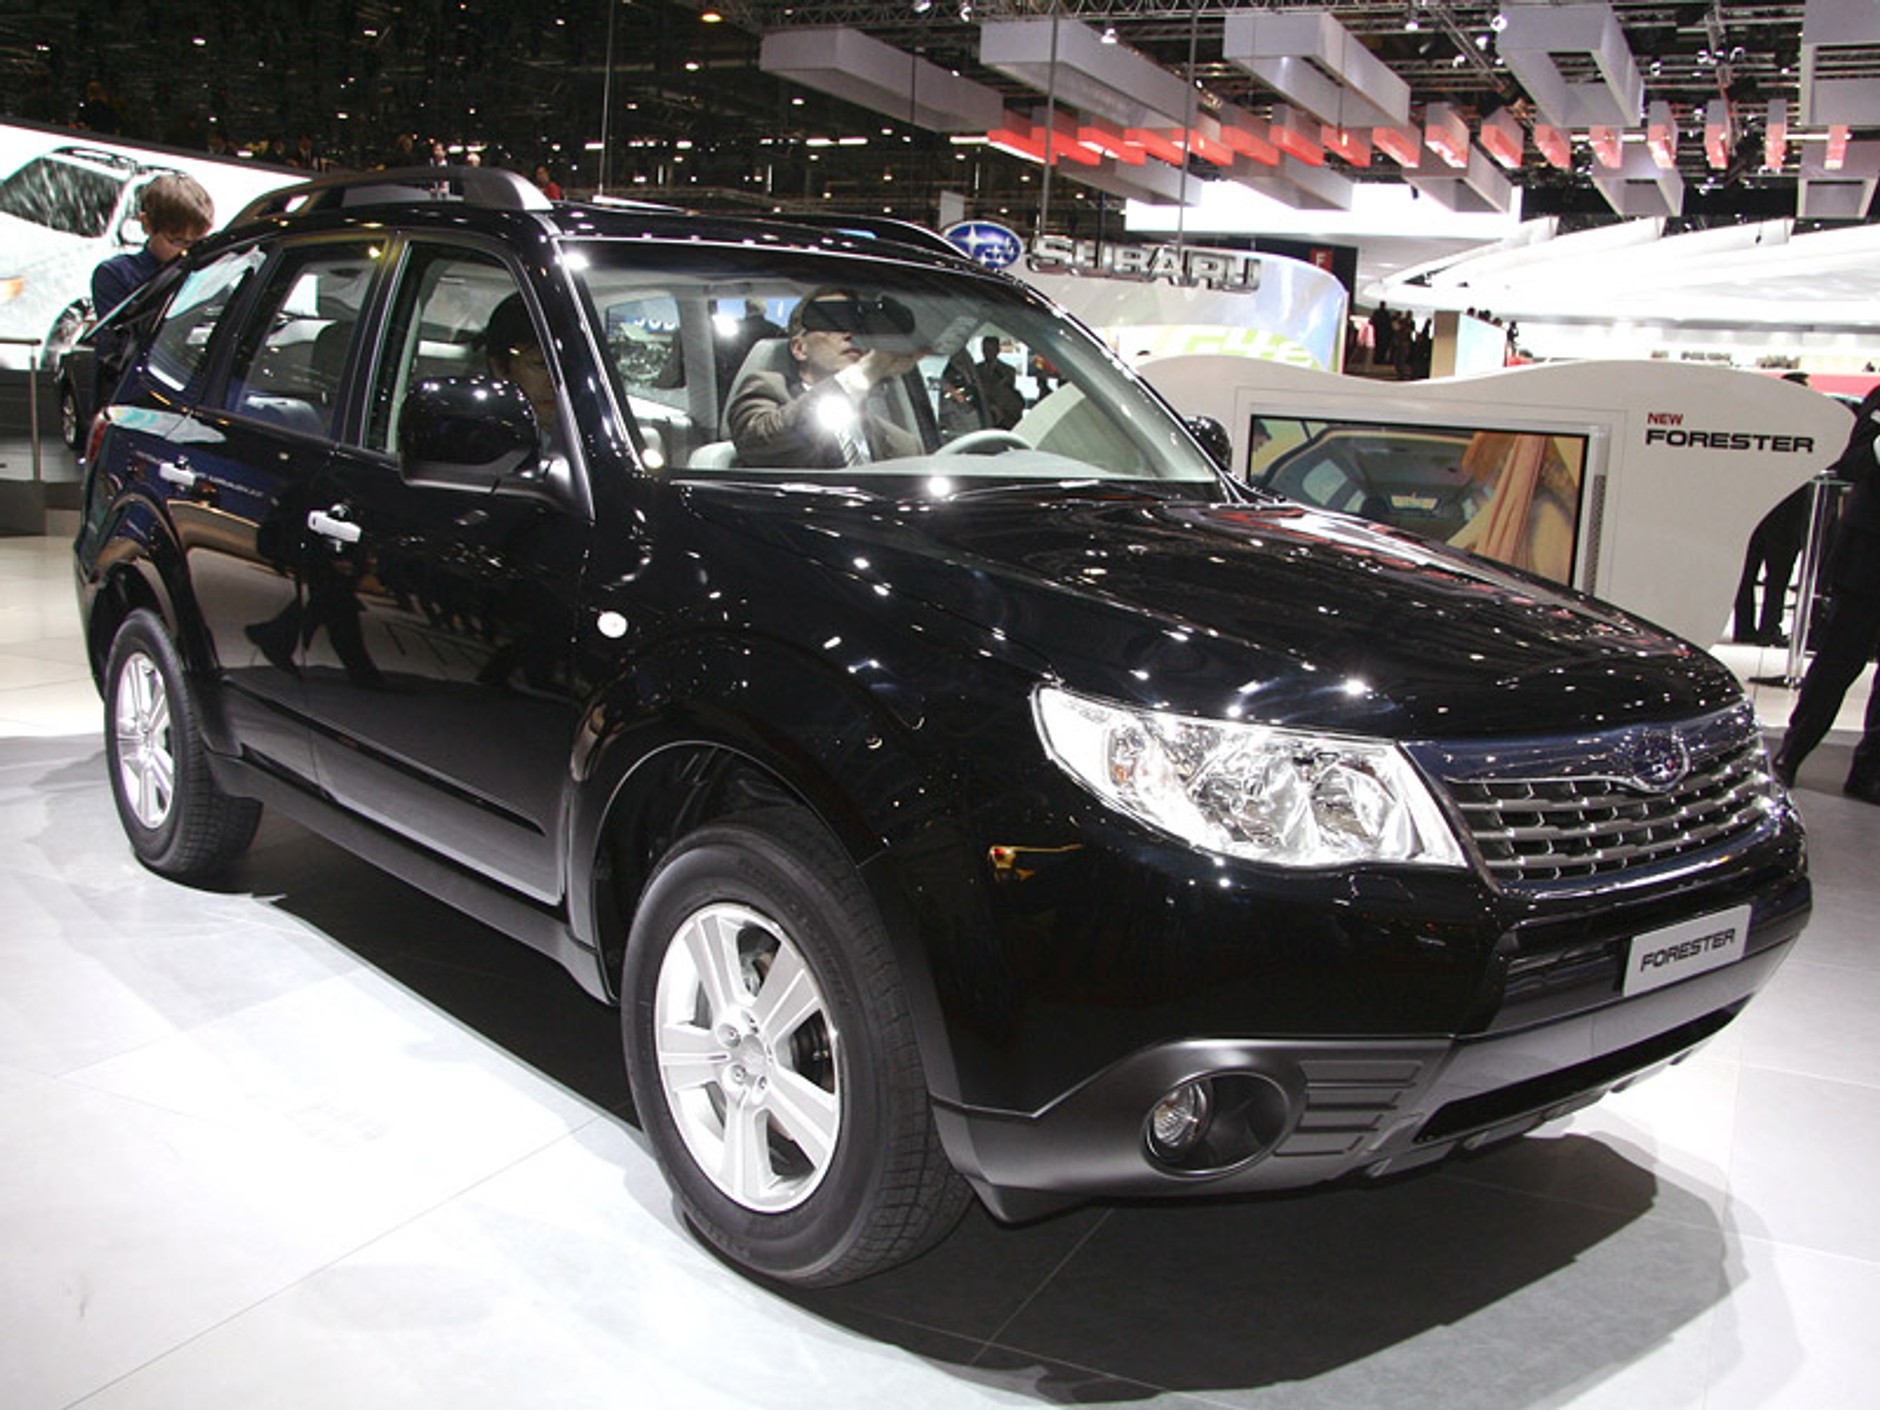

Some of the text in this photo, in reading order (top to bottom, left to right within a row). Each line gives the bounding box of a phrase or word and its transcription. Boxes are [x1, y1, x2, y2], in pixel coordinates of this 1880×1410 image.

[1029, 235, 1262, 293] SUBARU
[1647, 413, 1683, 425] NEW
[1645, 428, 1814, 453] FORESTER
[1640, 927, 1736, 972] FORESTER
